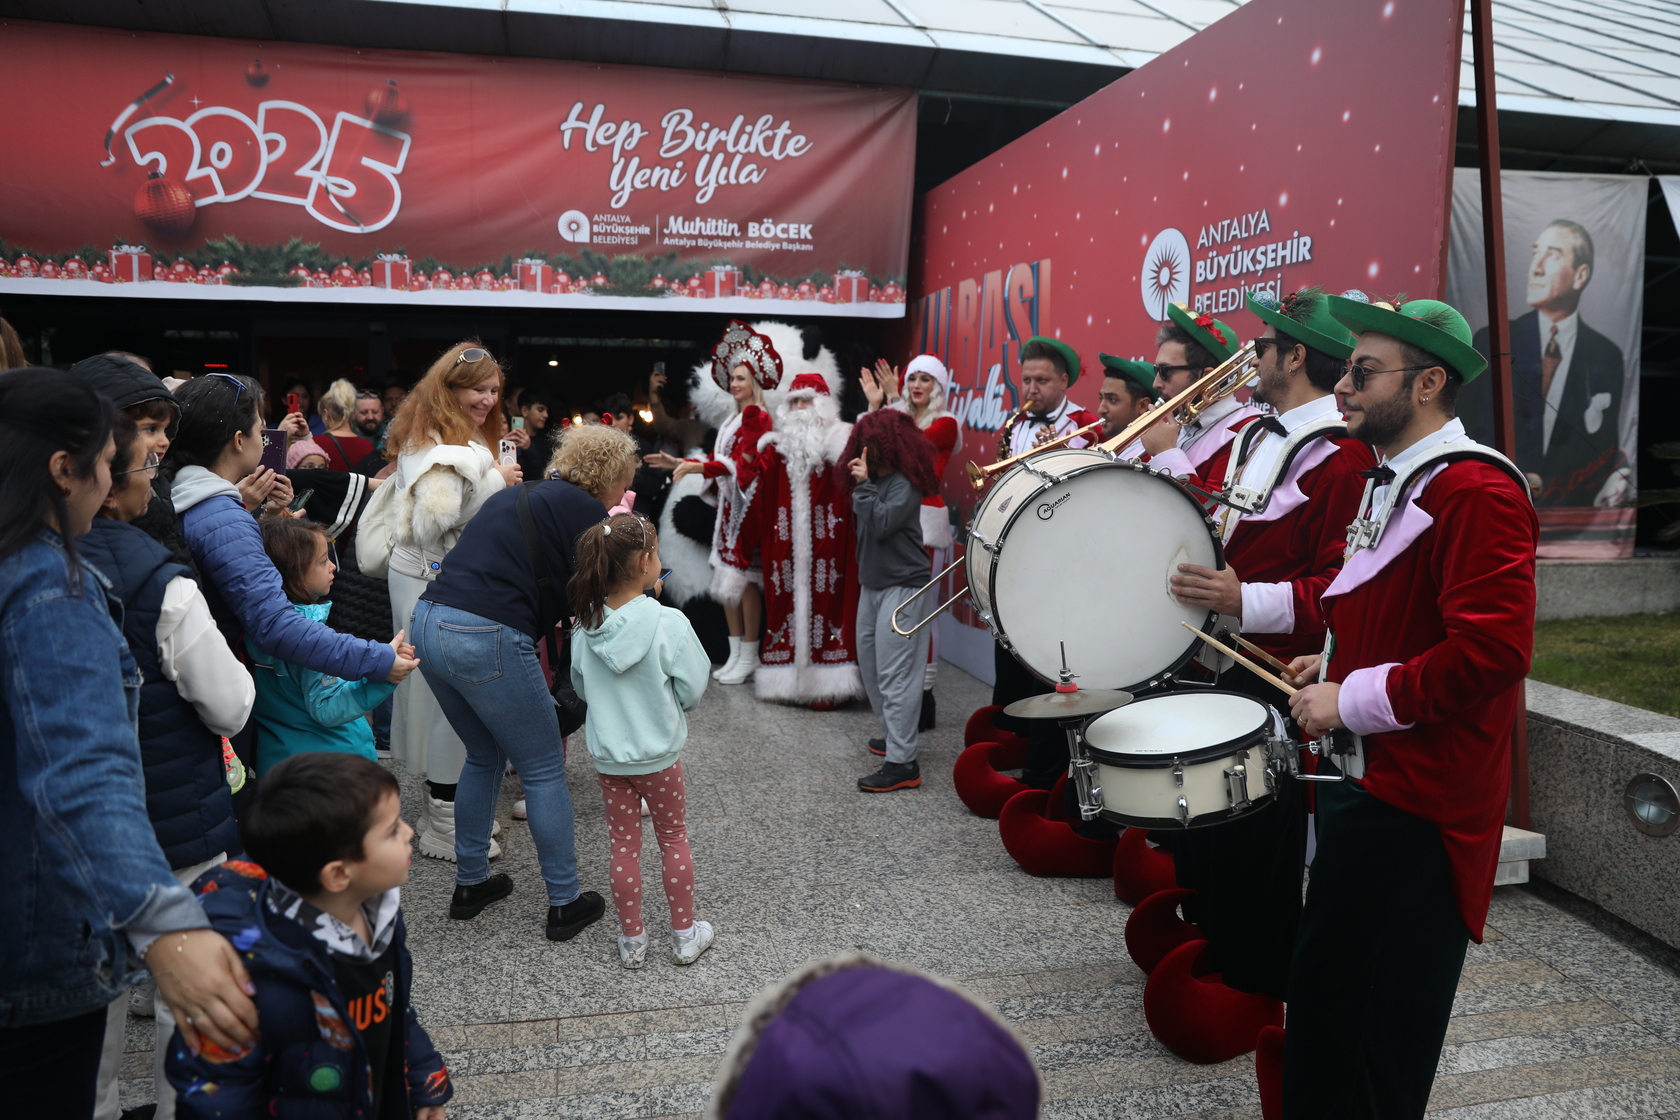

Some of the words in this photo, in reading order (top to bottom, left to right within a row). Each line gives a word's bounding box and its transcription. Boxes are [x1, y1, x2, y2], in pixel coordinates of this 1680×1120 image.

[560, 101, 649, 164] Hep
[659, 108, 813, 161] Birlikte
[124, 100, 412, 234] 2025
[609, 156, 687, 209] Yeni
[694, 152, 767, 204] Yıla
[592, 213, 632, 224] ANTALYA
[592, 222, 651, 236] BÜYÜKŞEHİR
[663, 215, 742, 237] Muhittin
[748, 218, 814, 240] BÖCEK
[1196, 208, 1271, 250] ANTALYA
[592, 235, 638, 246] BELEDİYESİ
[663, 237, 696, 248] Antalya
[698, 239, 744, 250] Büyükşehir
[745, 241, 781, 251] Belediye
[782, 242, 813, 252] Başkanı
[1195, 230, 1312, 283] BÜYÜKŞEHİR
[1043, 491, 1072, 515] AQUARIAN
